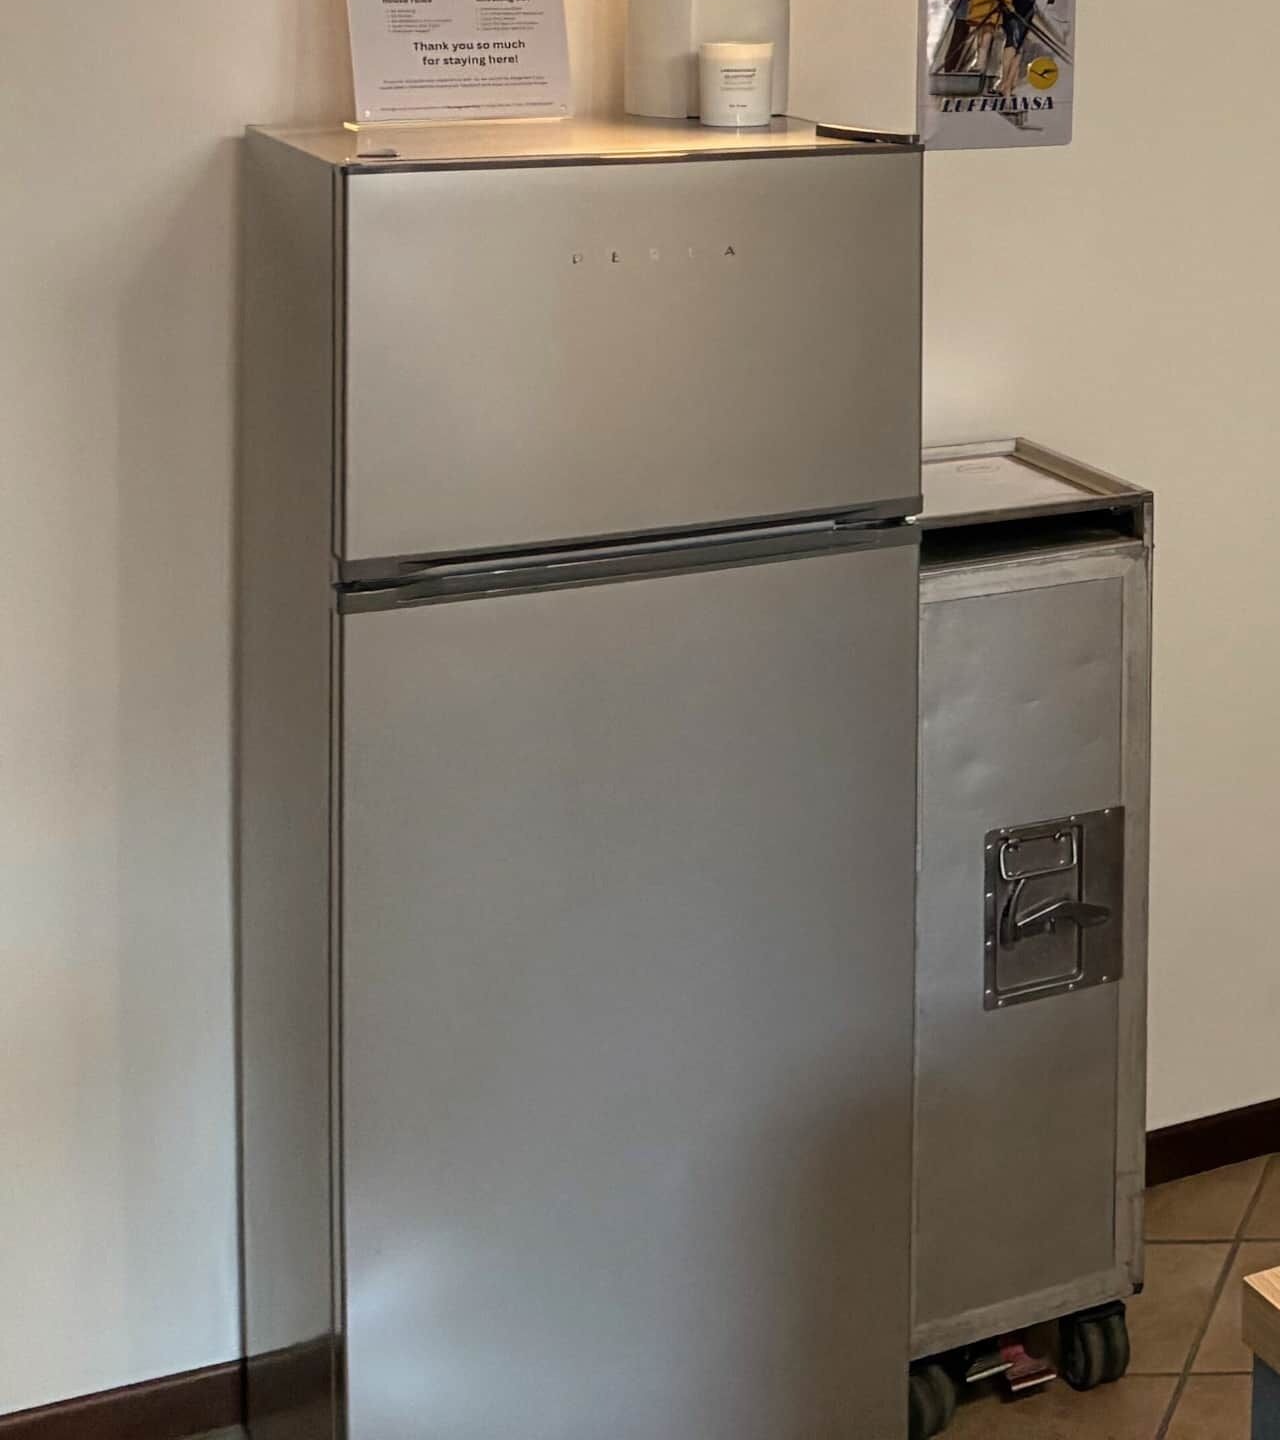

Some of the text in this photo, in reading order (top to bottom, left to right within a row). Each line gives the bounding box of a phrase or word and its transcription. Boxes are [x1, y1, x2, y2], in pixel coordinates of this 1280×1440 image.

[413, 39, 526, 54] Thank you so much
[422, 54, 519, 67] for staying here!
